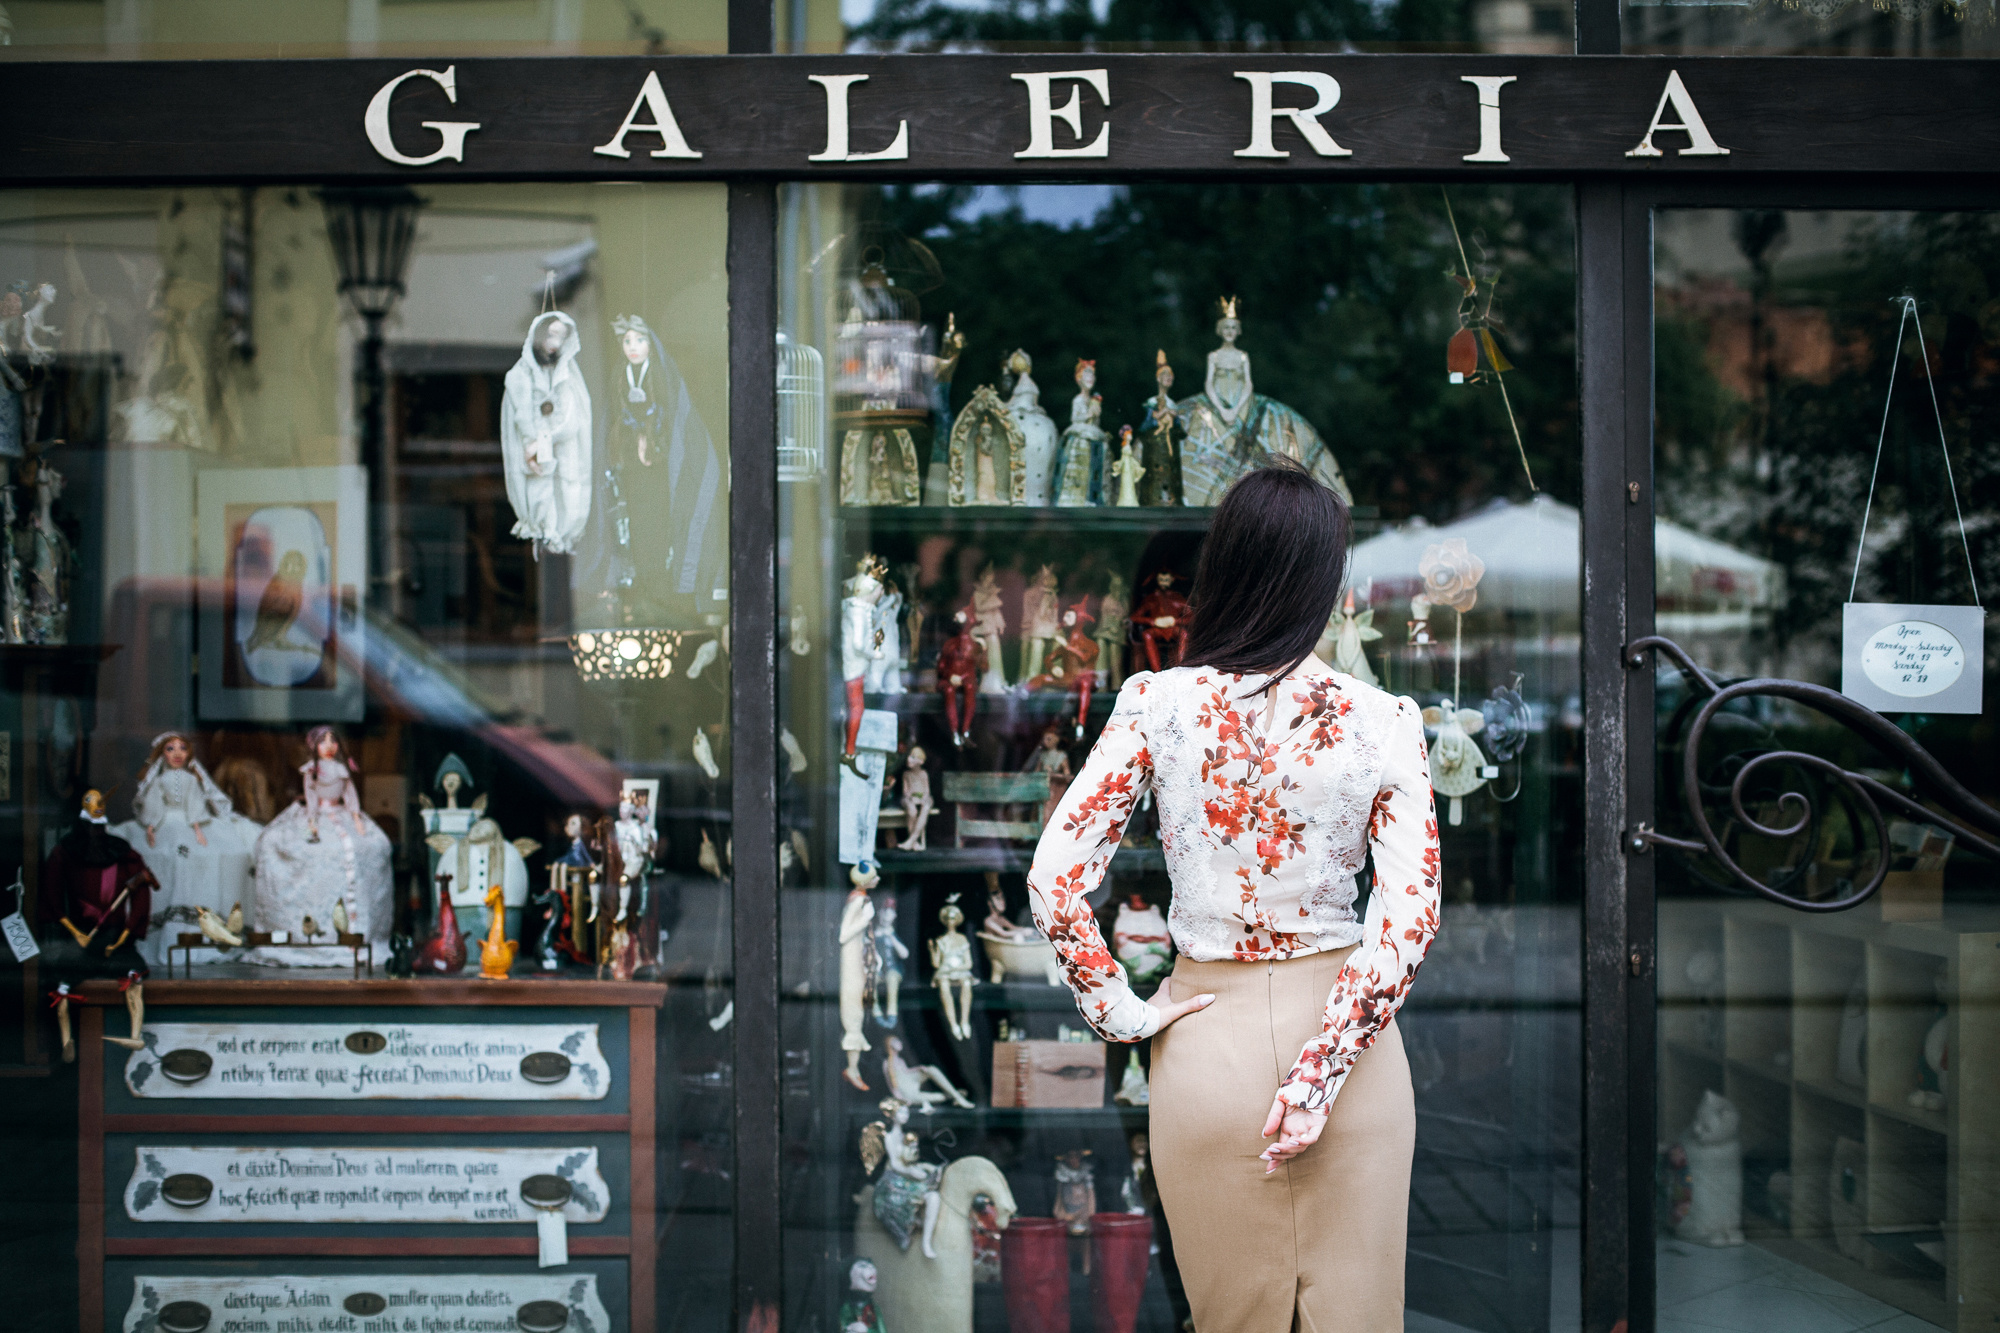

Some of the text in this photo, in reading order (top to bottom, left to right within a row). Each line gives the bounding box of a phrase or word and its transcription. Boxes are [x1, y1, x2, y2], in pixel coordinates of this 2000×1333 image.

[365, 65, 1730, 167] GALERIA
[1898, 625, 1921, 639] Open
[1874, 642, 1908, 656] Monday
[1916, 641, 1954, 657] Saturday
[1892, 660, 1925, 674] Sunday
